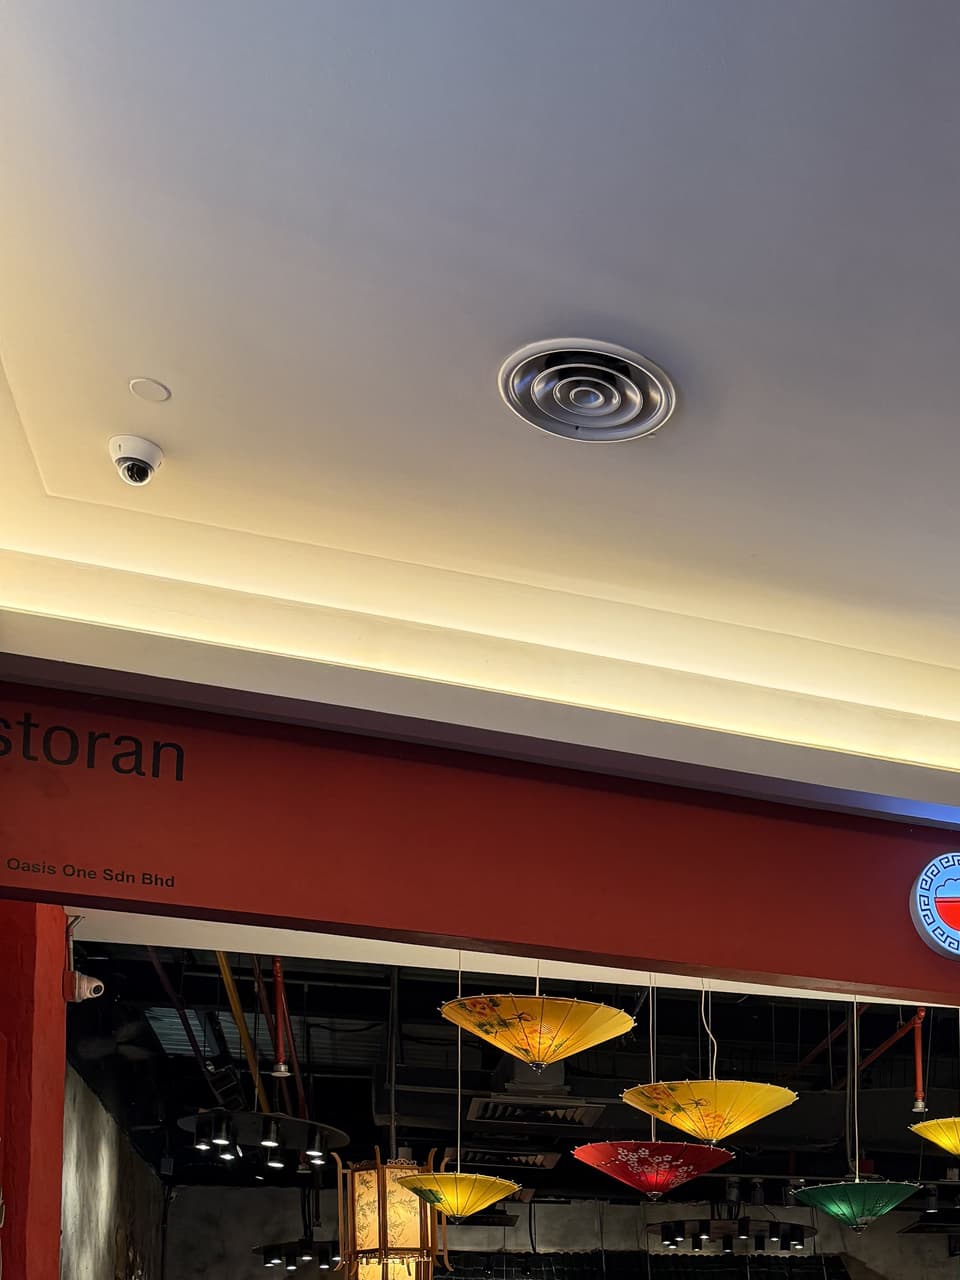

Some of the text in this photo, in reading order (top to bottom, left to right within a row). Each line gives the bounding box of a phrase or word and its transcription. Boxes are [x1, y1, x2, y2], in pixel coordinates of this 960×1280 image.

[6, 857, 175, 888] Oasis One Sdn Bhd
